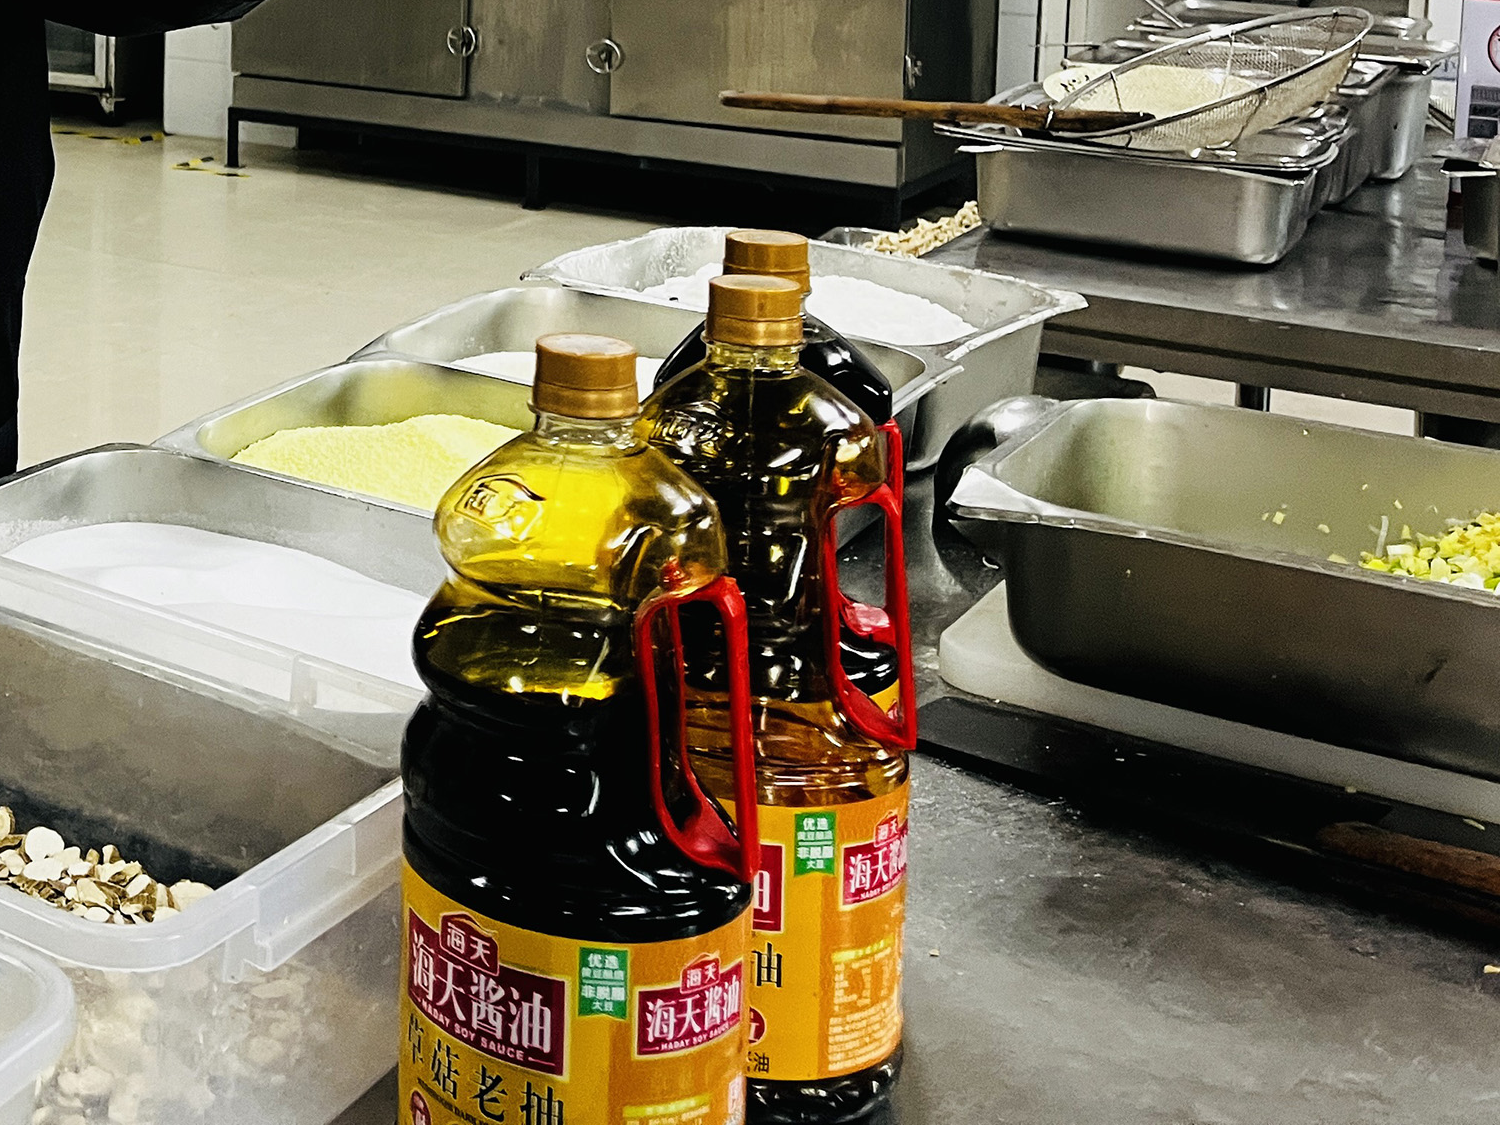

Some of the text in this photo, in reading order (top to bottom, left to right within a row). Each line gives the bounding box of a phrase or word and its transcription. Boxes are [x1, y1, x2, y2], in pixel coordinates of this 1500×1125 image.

[447, 922, 491, 967] 海天
[412, 929, 551, 1055] 海天酱油
[686, 962, 717, 988] 海天
[645, 975, 740, 1043] 海天酱油
[408, 1012, 564, 1125] 草菇老抽
[454, 1022, 476, 1042] SOY
[481, 1036, 525, 1061] SAUCE
